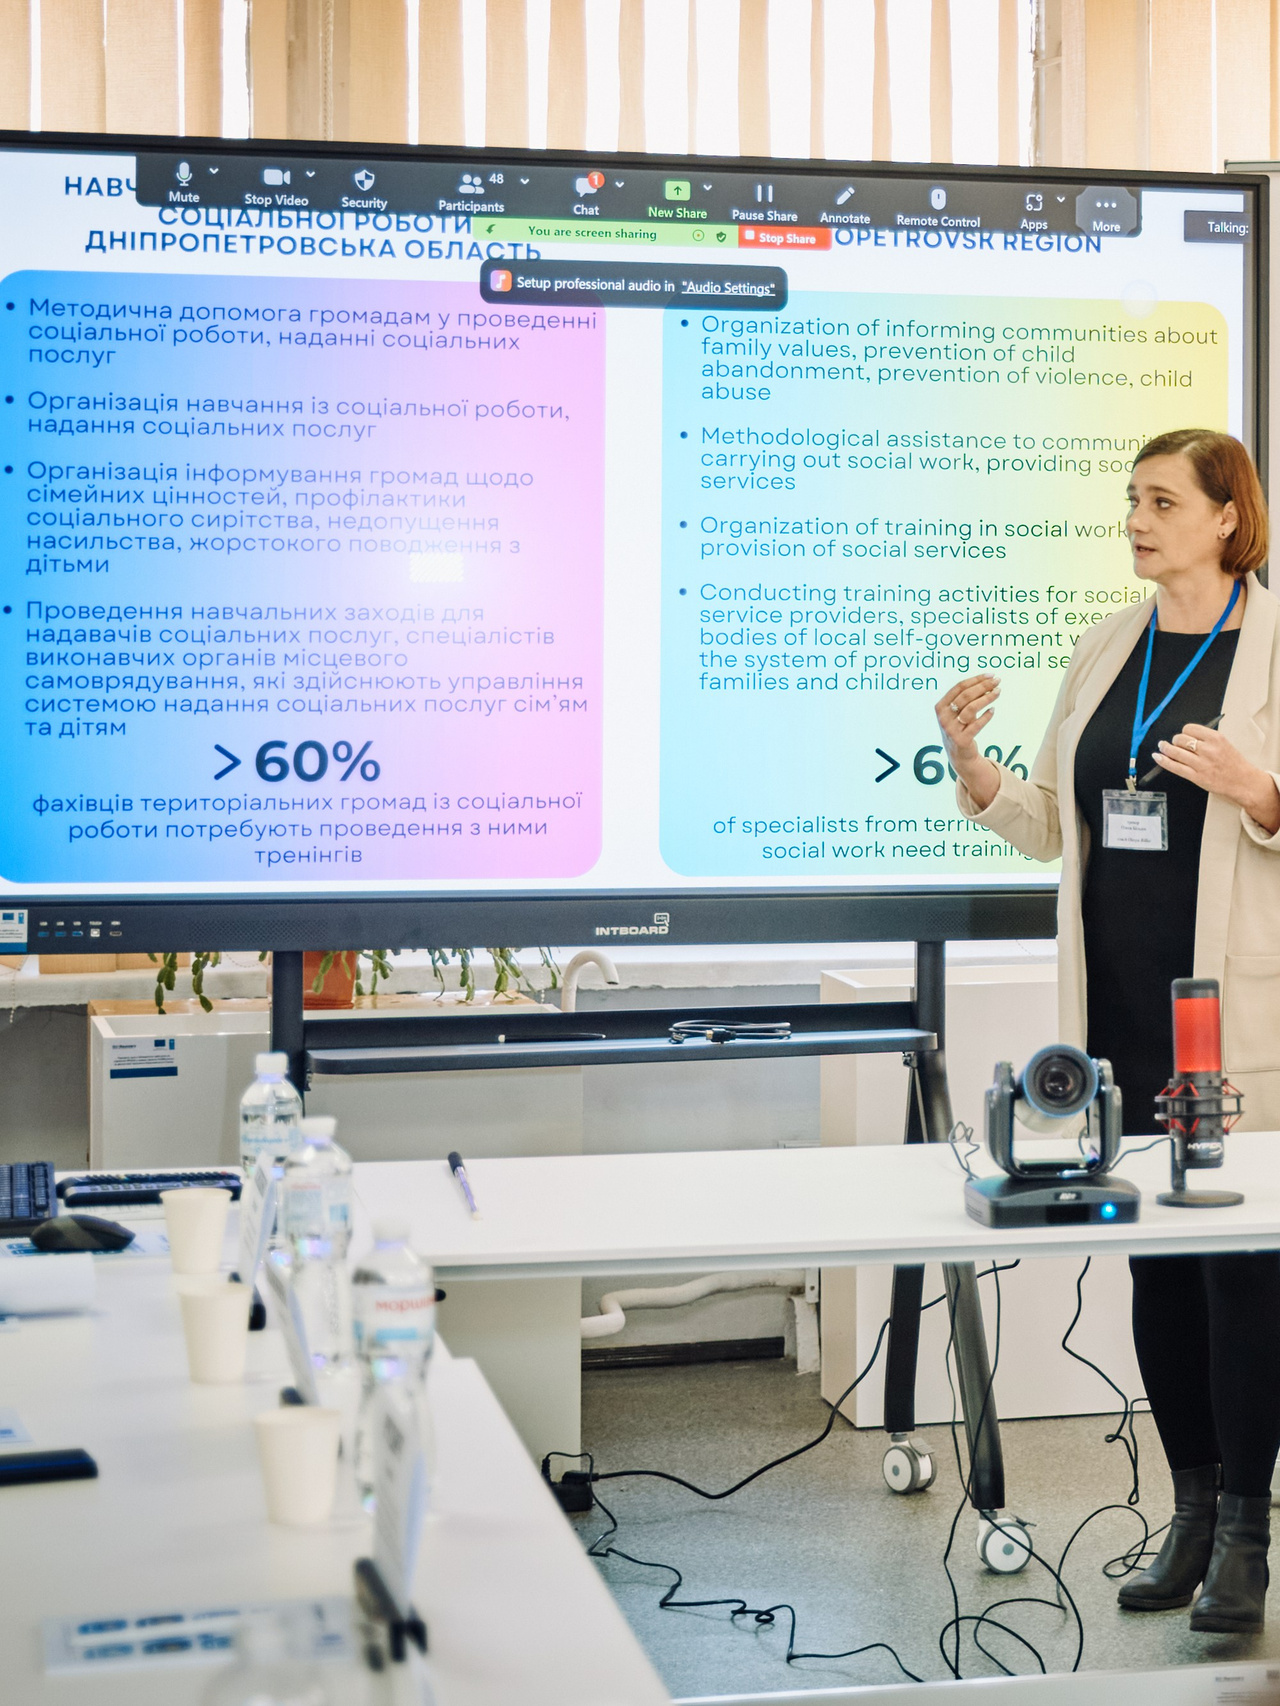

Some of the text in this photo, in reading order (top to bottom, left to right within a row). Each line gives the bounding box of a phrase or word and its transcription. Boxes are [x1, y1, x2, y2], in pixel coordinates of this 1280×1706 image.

[489, 173, 504, 184] 48
[169, 191, 200, 203] Mute
[244, 193, 309, 208] Stop Video
[341, 196, 388, 211] Security
[438, 199, 505, 214] Participants
[573, 204, 600, 216] Chat
[648, 206, 708, 219] New Share
[732, 209, 798, 222] Pause Share
[820, 212, 871, 224] Annotate
[897, 214, 981, 228] Remote Control
[1020, 218, 1048, 232] Apps
[1093, 220, 1121, 232] More
[527, 225, 657, 242] You are screen sharing
[1207, 221, 1248, 235] Talking:
[85, 230, 542, 261] ДНІПРОПЕТРОВСЬКА ОБЛАСТЬ
[759, 233, 816, 246] Stop Share
[834, 227, 1102, 254] OPETROVSK REGION
[517, 276, 776, 295] Setup professional audio in "Audio Settings"
[30, 298, 596, 331] Методична допомога громадам у проведенні
[29, 322, 520, 351] соціальної роботи, наданні соціальних
[702, 315, 1218, 345] Organization of informing communities about
[29, 349, 116, 368] послуг
[28, 391, 569, 422] Організація навчання із соціальної роботи,
[28, 417, 376, 442] надання соціальних послуг
[702, 427, 1147, 452] Methodological assistance to communi
[701, 450, 1091, 477] carrying out social work, providing
[701, 473, 796, 490] services
[701, 516, 1128, 541] Organization of training in social work
[699, 673, 938, 690] families and children
[255, 740, 381, 783] 60%
[32, 792, 583, 816] фахівців територіальних громад із соціальної
[69, 819, 547, 843] роботи потребують проведення з ними
[713, 816, 736, 834] of
[742, 816, 859, 837] specialists
[865, 815, 917, 832] from
[255, 845, 362, 868] тренінгів
[762, 839, 1033, 860] social work need trainin
[594, 925, 670, 937] INTBOARD
